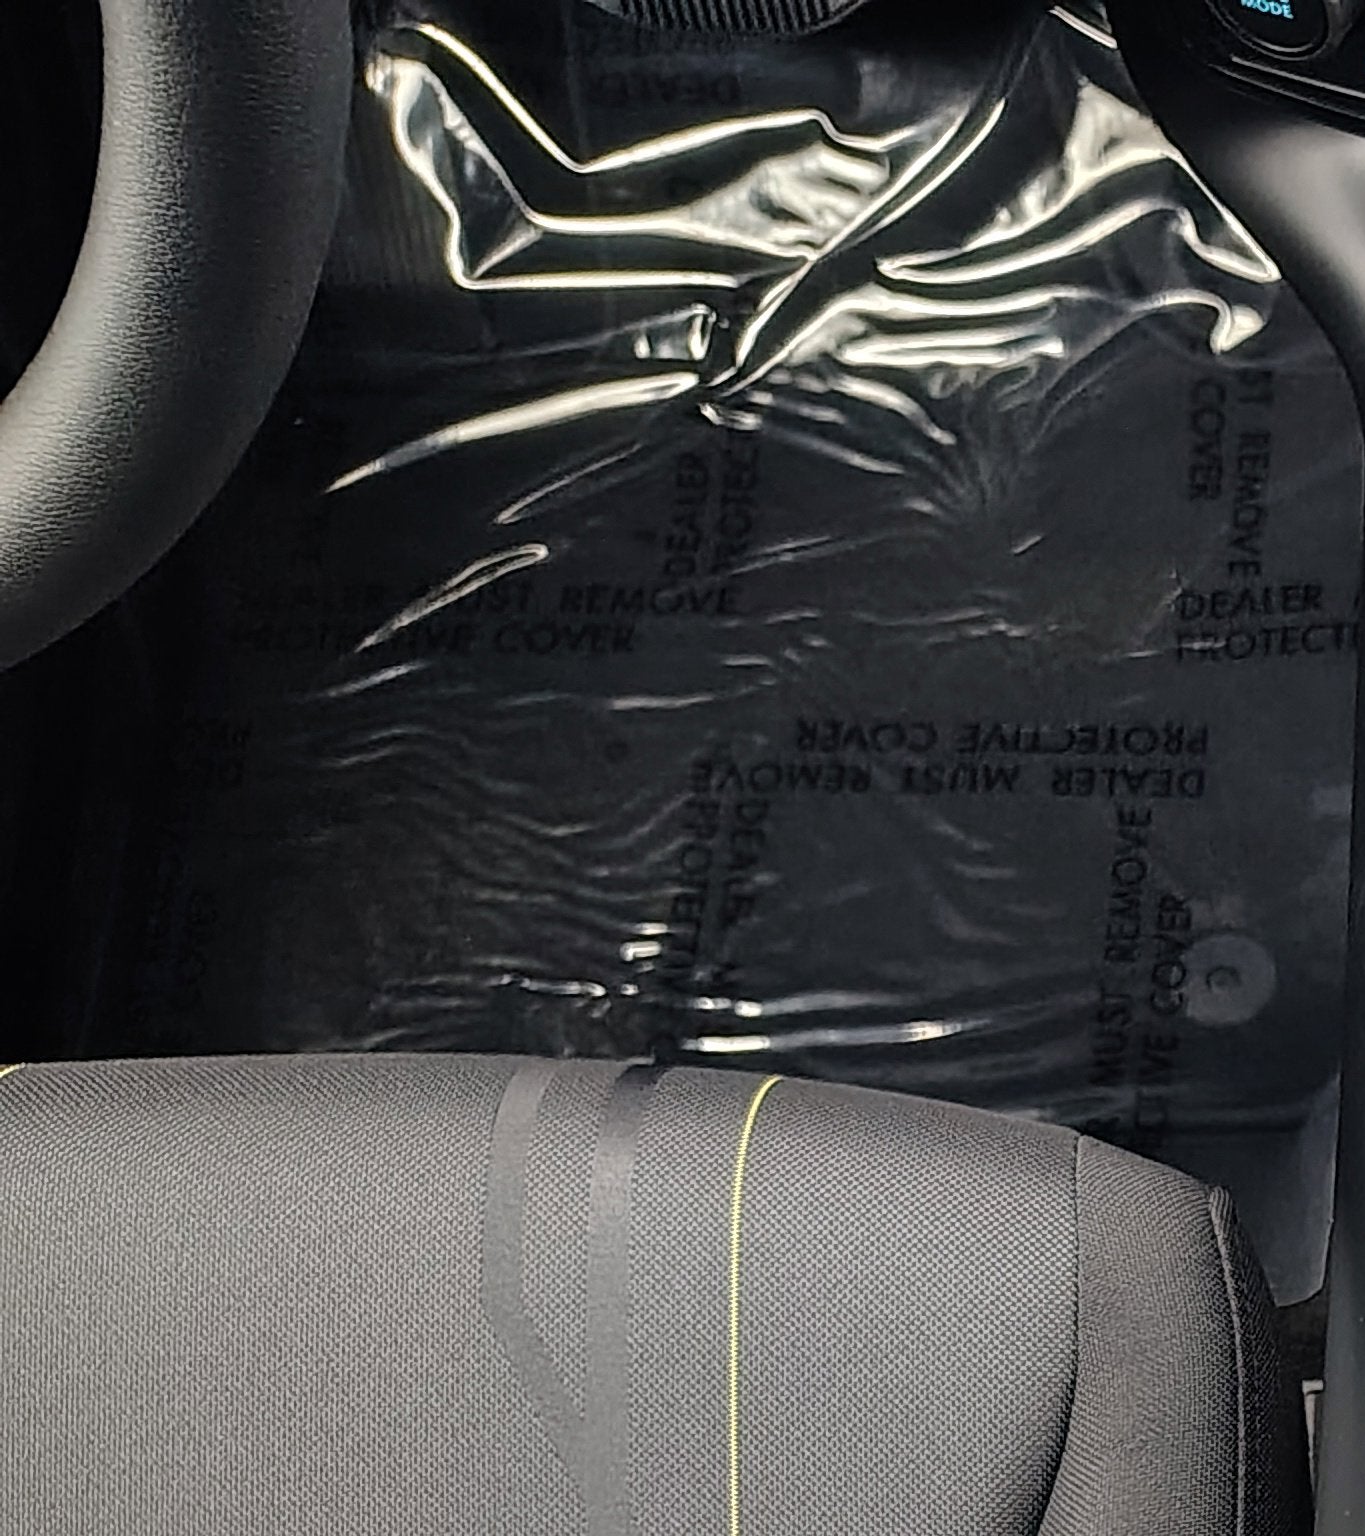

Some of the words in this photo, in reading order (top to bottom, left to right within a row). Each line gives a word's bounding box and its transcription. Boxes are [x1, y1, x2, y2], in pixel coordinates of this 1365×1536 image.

[1187, 376, 1227, 501] COVER
[664, 451, 709, 576] DEALER
[1228, 431, 1272, 578] REMOVE
[560, 584, 741, 616] REMOVE
[1176, 583, 1322, 621] DEALER
[494, 622, 637, 653] COVER
[795, 718, 939, 754] COVER
[957, 720, 1209, 756] PROTECTIVE
[691, 758, 872, 795] REMOVE
[901, 764, 1020, 795] MUST
[1051, 766, 1206, 798] DEALER
[1103, 806, 1152, 963] REMOVE
[1150, 894, 1194, 1016] COVER
